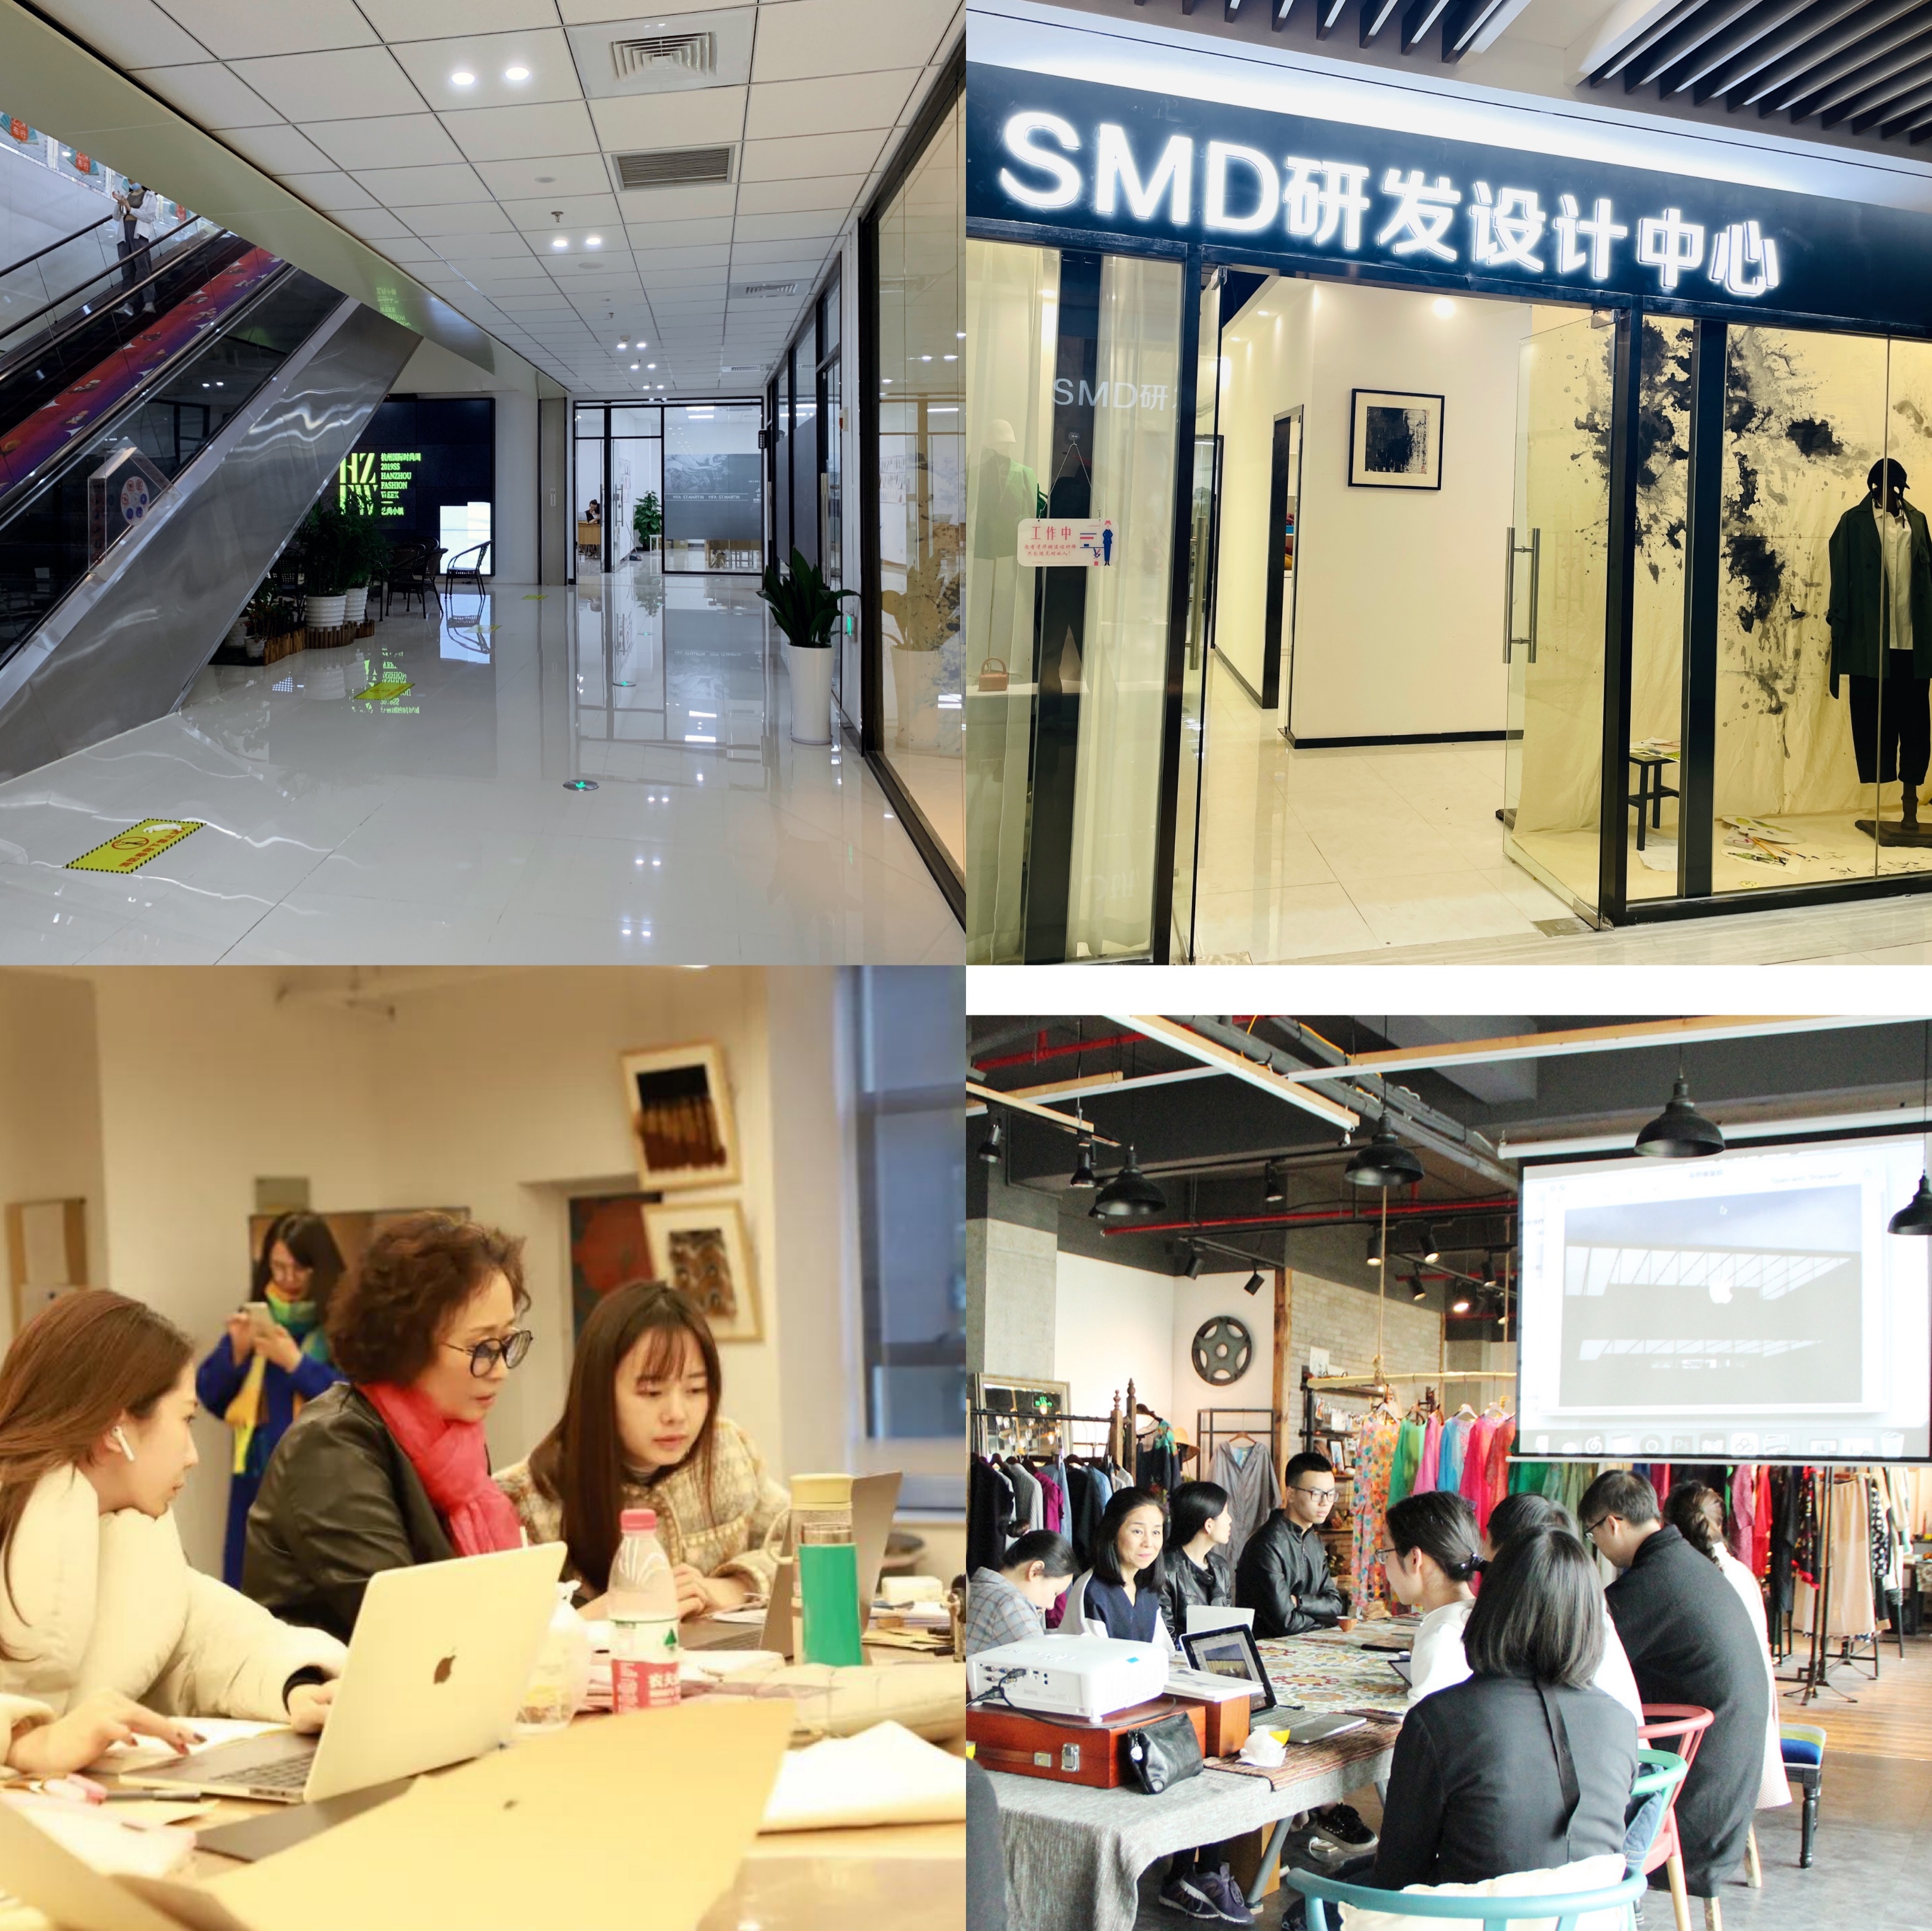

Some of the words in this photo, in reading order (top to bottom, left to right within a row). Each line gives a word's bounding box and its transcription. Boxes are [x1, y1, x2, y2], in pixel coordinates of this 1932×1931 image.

[998, 111, 1780, 296] SMD研发设计中心
[1052, 378, 1178, 411] SMD研
[340, 453, 376, 483] HZ
[1030, 526, 1071, 541] 工作中
[1675, 1439, 1690, 1452] Ps
